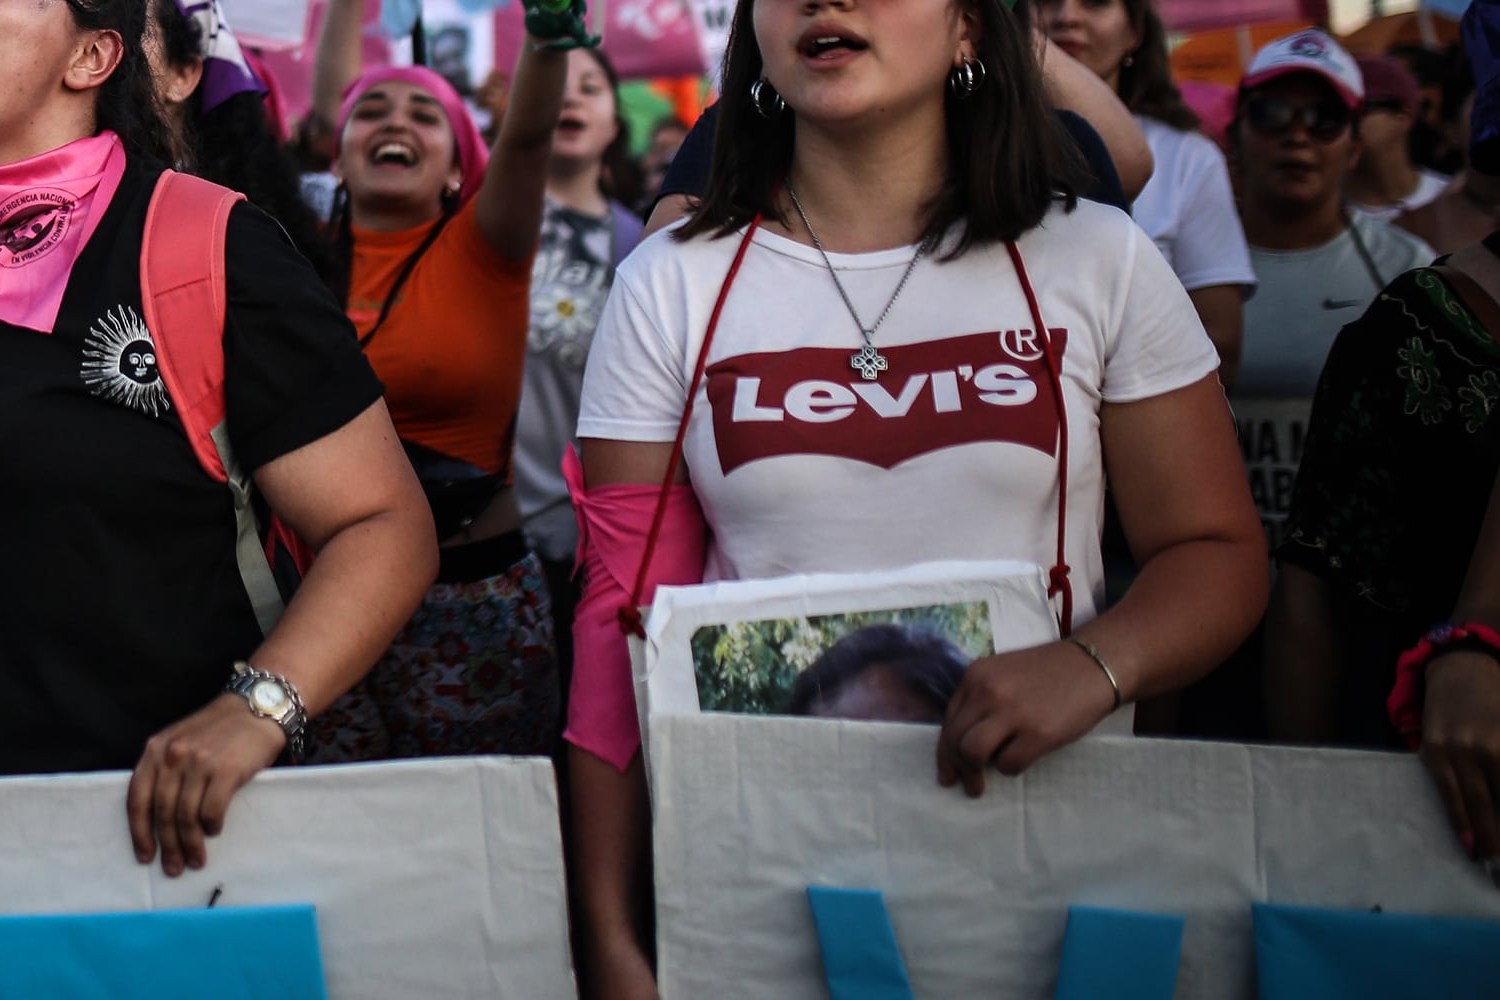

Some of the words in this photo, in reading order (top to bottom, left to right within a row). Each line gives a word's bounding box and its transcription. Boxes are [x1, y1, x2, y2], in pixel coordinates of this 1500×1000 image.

[11, 255, 21, 264] EN
[21, 240, 53, 262] VIOLENCIA
[50, 214, 67, 242] CONTRA
